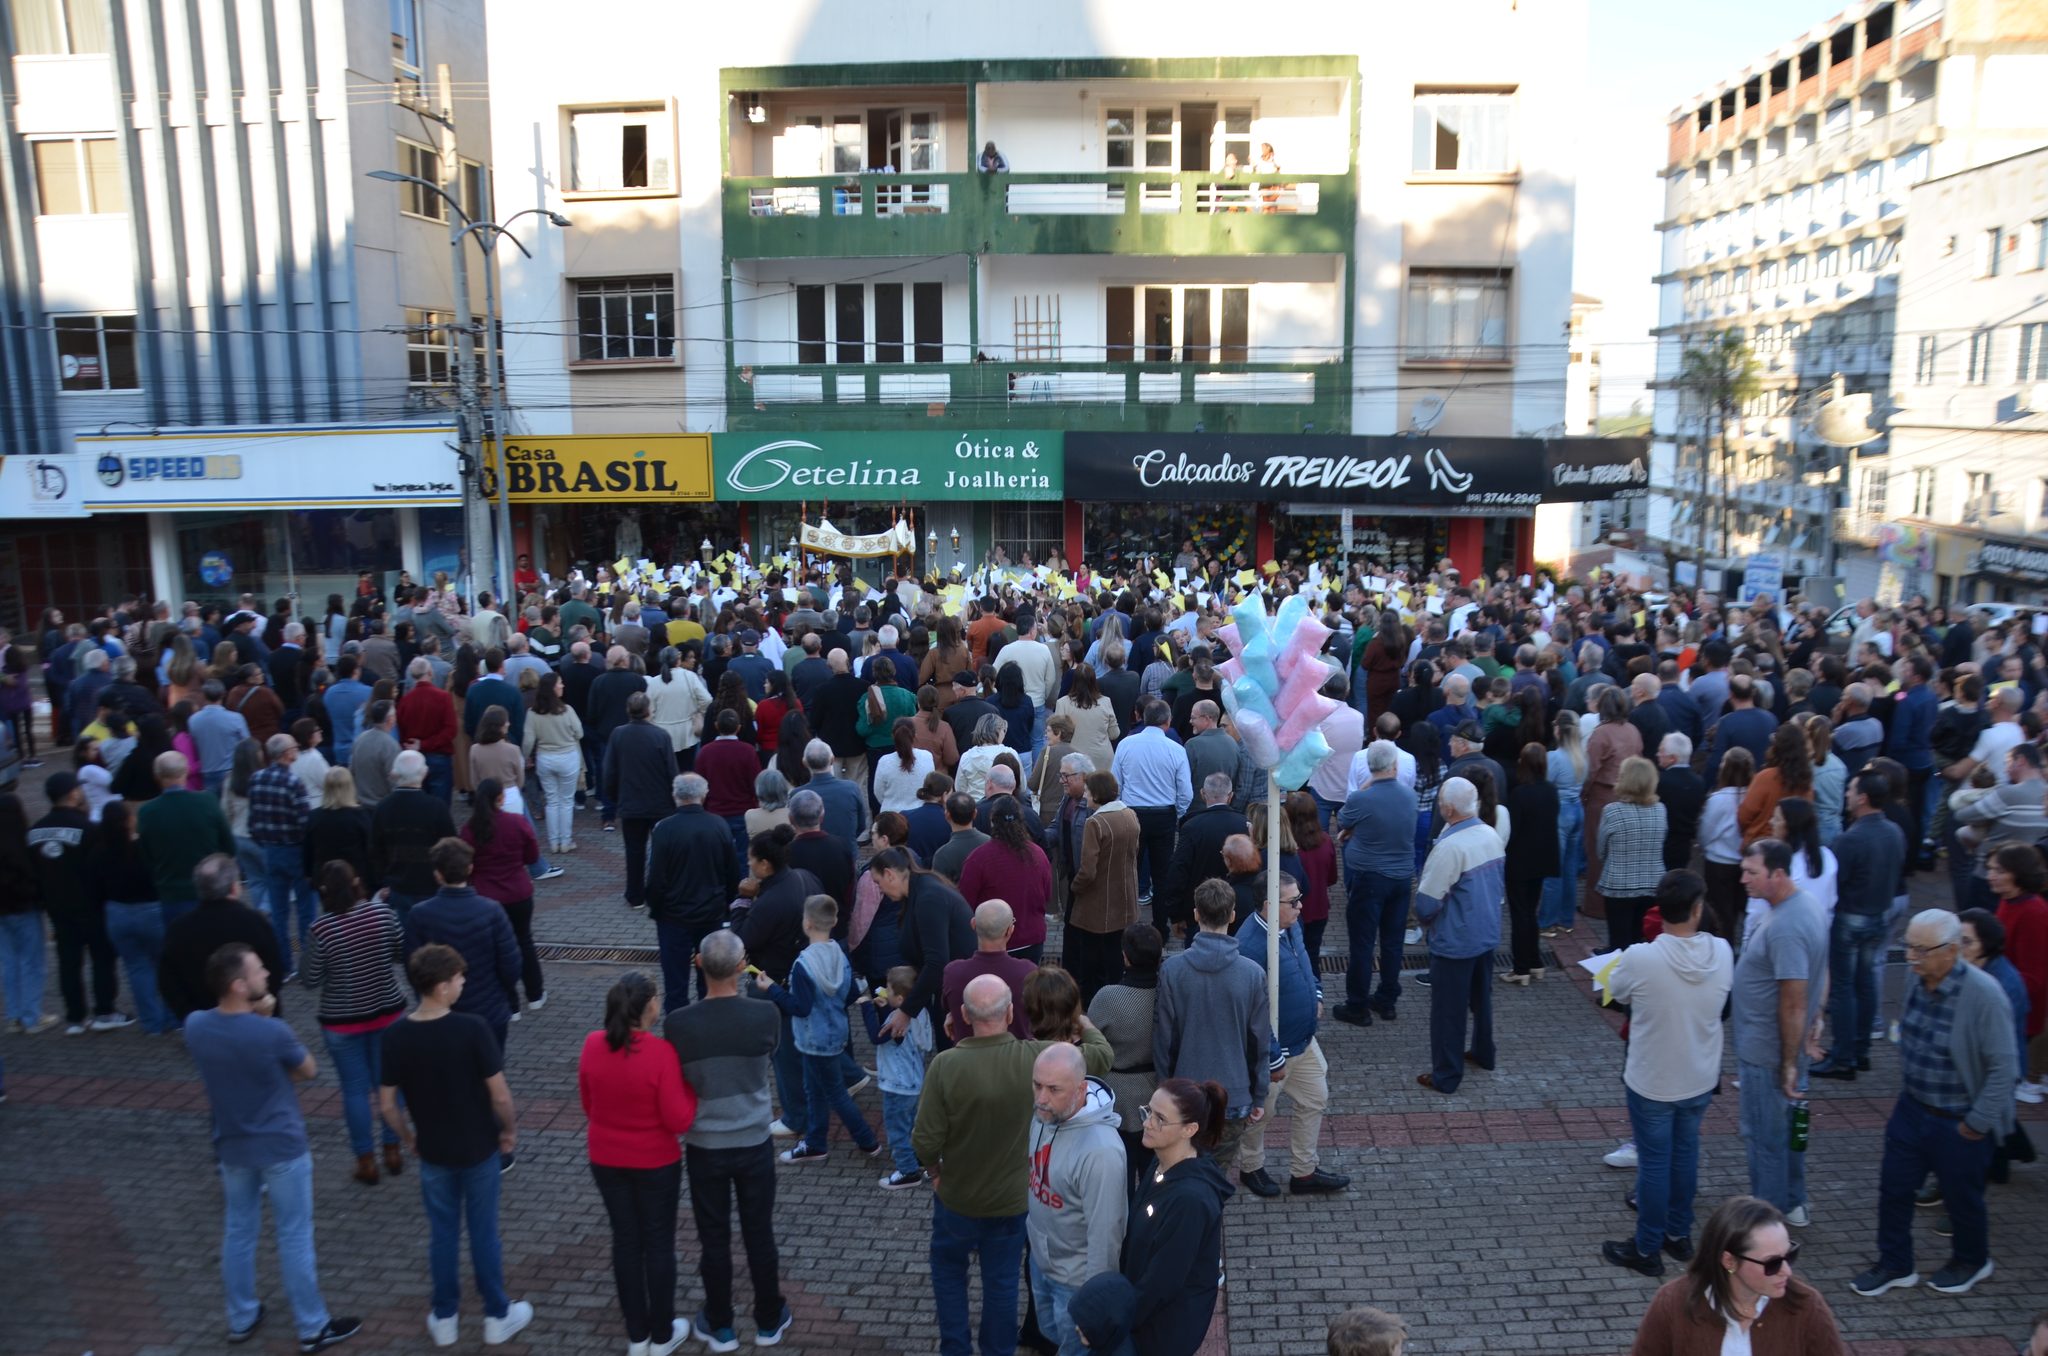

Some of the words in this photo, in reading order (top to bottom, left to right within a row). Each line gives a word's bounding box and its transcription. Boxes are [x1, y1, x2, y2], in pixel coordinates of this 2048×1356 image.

[505, 445, 556, 461] Casa
[955, 432, 1015, 459] Ótica
[1022, 441, 1040, 459] &
[944, 468, 1051, 488] Joalheria
[1132, 449, 1257, 488] Calçados
[1259, 454, 1413, 490] TREVISOL
